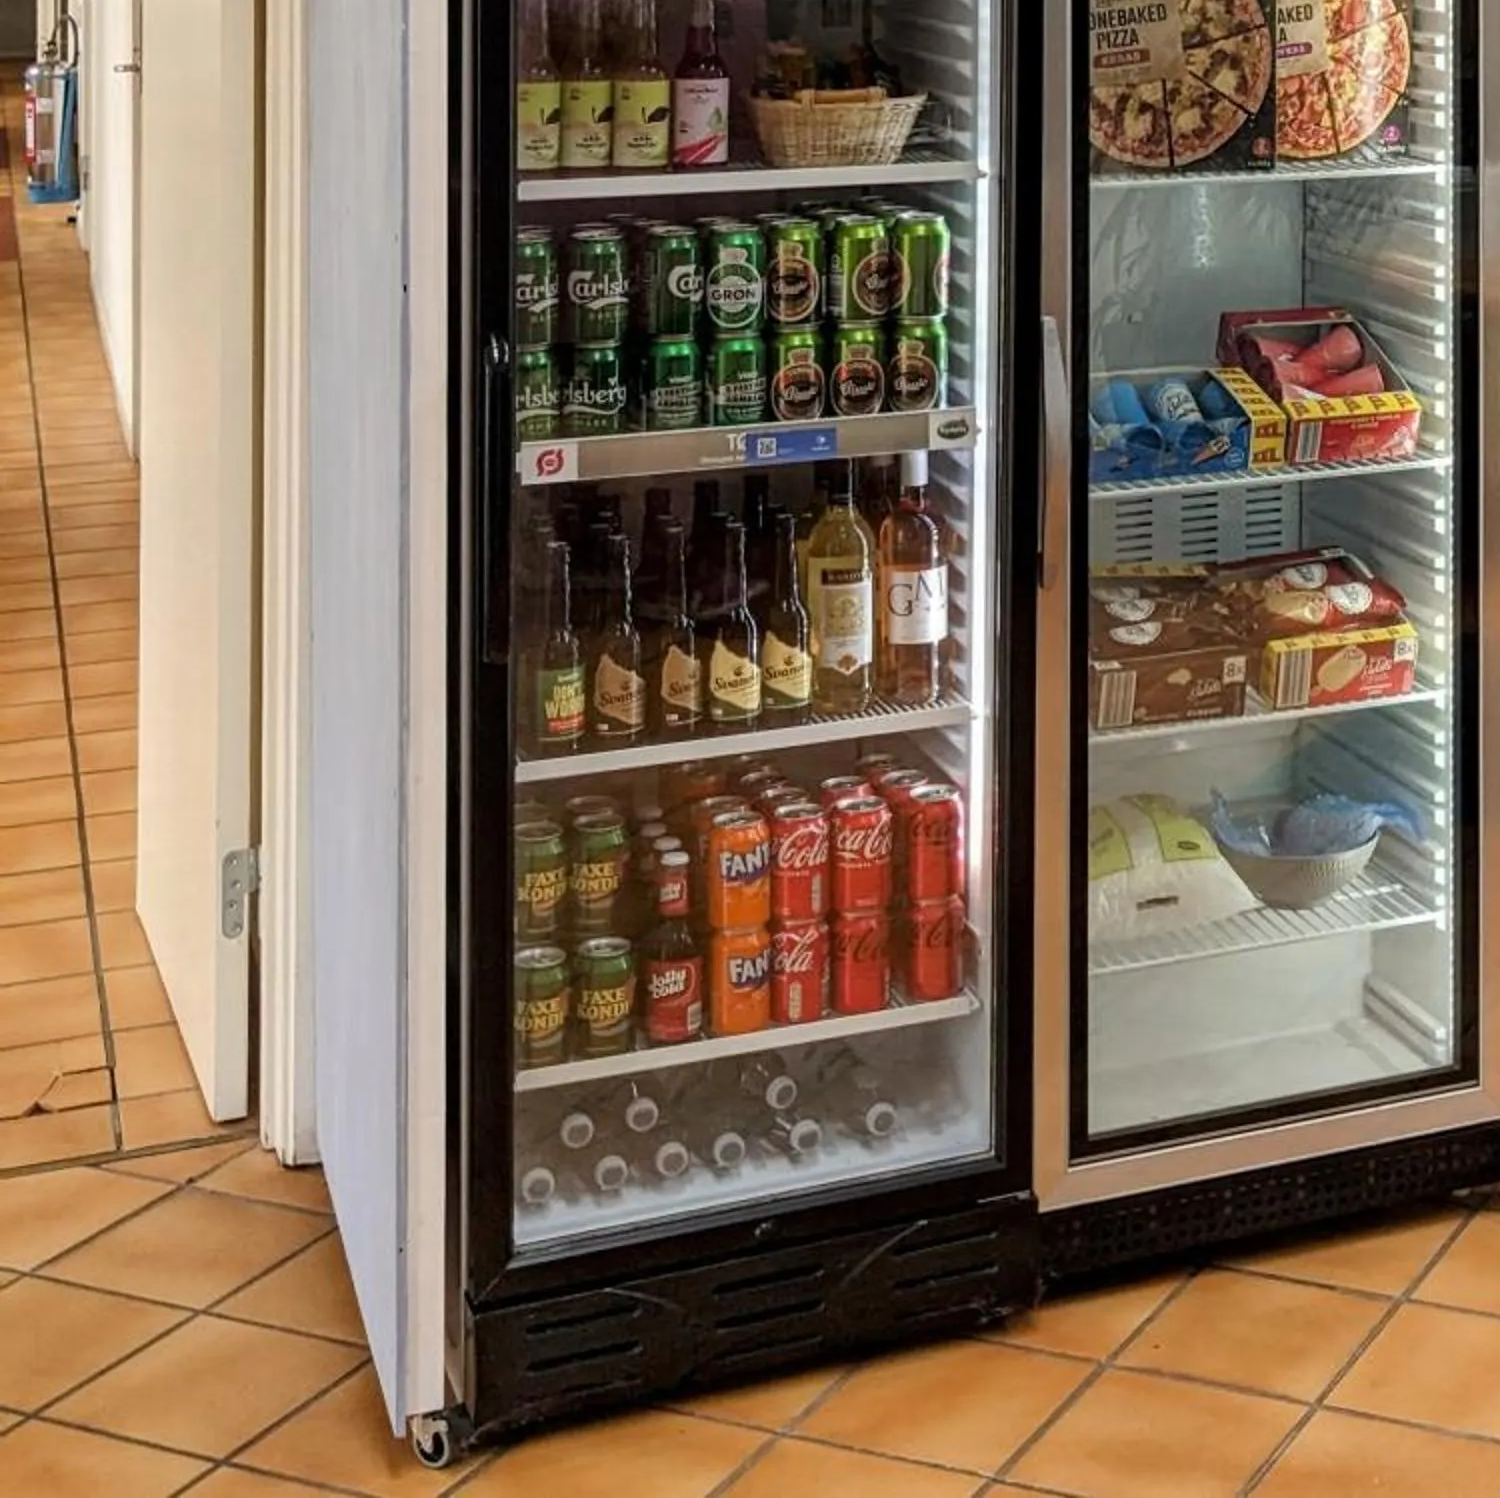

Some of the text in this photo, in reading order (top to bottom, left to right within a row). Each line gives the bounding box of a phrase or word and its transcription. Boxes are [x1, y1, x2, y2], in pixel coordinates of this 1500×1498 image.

[1096, 28, 1139, 51] PIZZA
[710, 286, 756, 302] GRØN
[581, 987, 626, 1004] FAXE
[577, 1001, 629, 1020] KONDI
